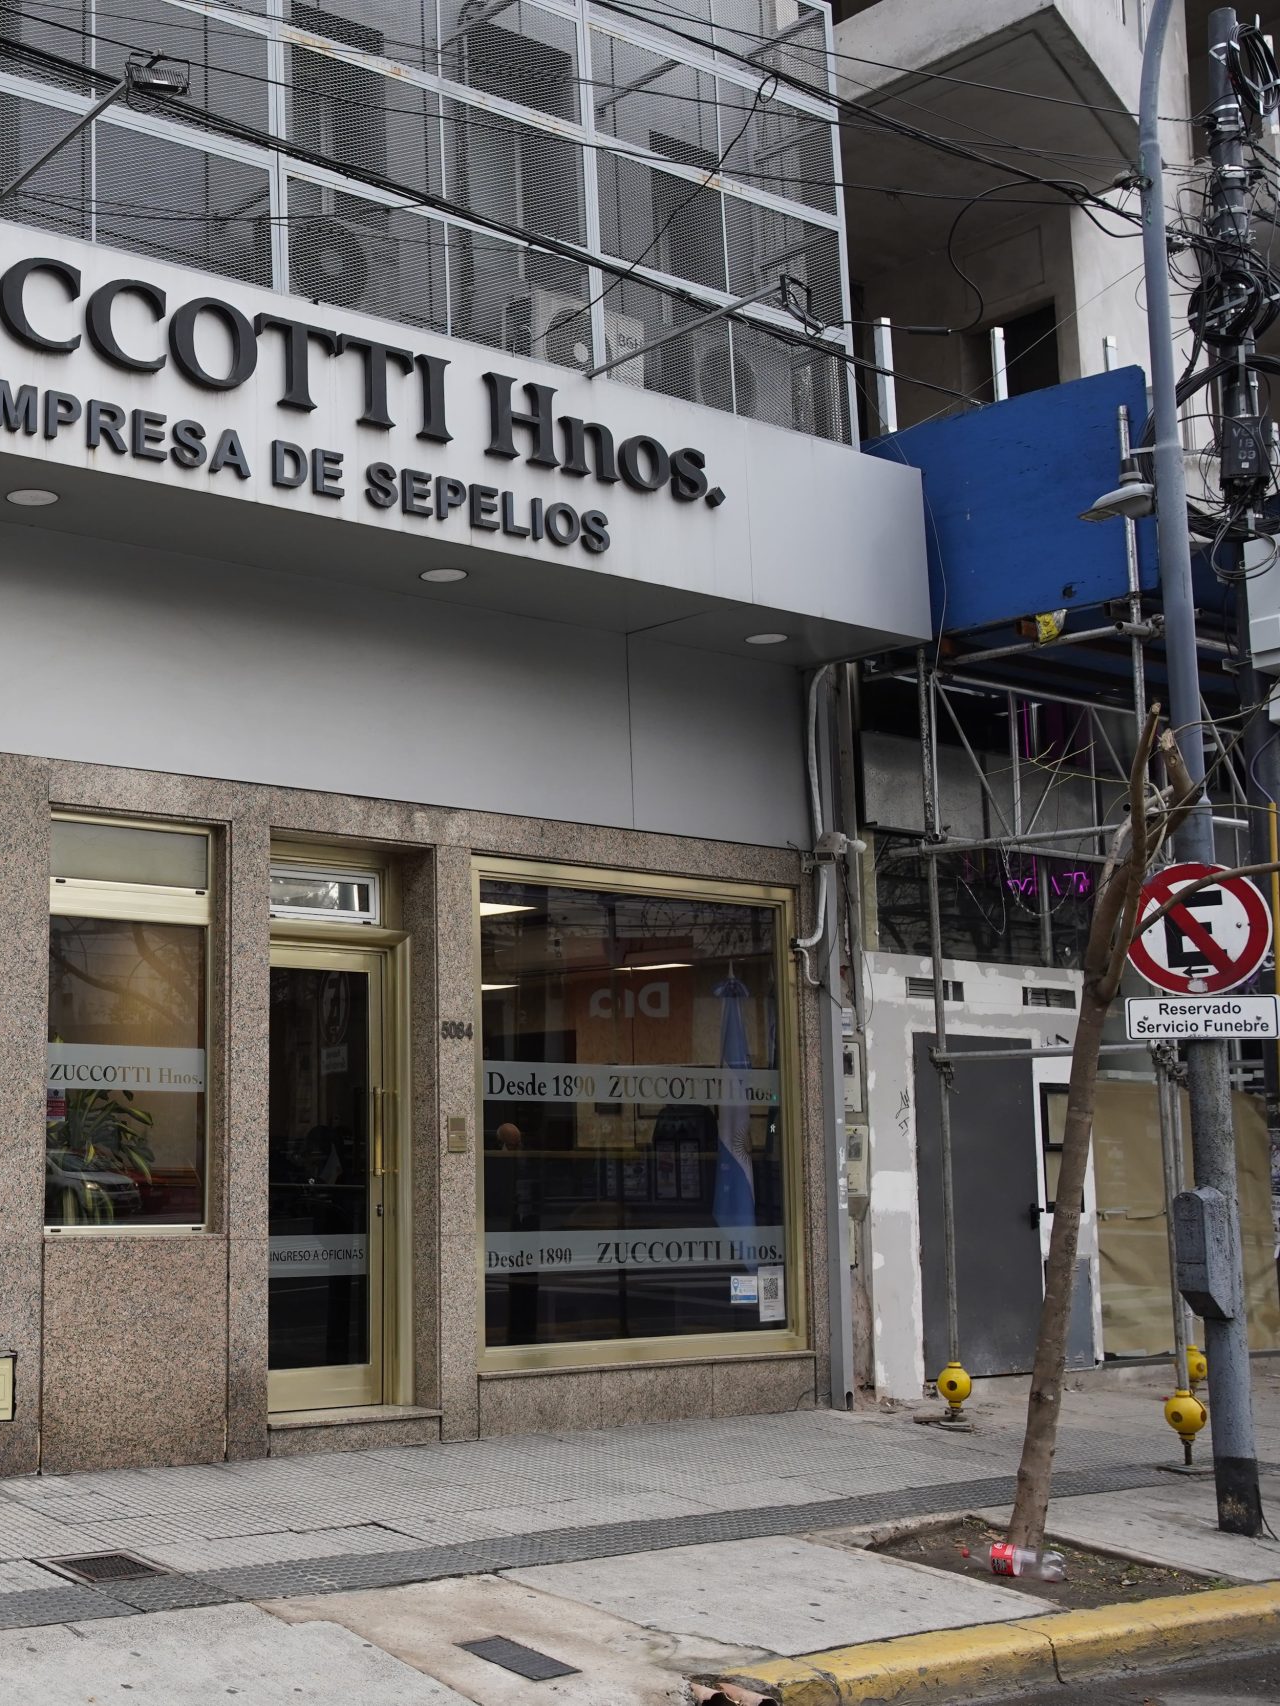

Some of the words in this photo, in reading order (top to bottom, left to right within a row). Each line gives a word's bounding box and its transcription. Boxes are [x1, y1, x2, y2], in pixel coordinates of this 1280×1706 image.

[484, 372, 727, 510] Hnos.
[271, 439, 345, 499] DE
[365, 462, 612, 554] SEPELIOS
[1158, 1001, 1242, 1016] Reservado
[440, 1019, 474, 1041] 5084
[1136, 1020, 1199, 1034] Servicio
[1204, 1019, 1270, 1033] Funebre
[49, 1063, 151, 1083] ZUCCOTTI
[158, 1067, 203, 1086] Hnos.
[486, 1071, 547, 1096] Desde
[552, 1074, 595, 1097] 1890
[607, 1075, 723, 1100] ZUCCOTTI
[269, 1250, 311, 1262] INGRESO
[313, 1250, 320, 1261] A
[321, 1248, 364, 1261] OFICINAS
[487, 1249, 533, 1268] Desde
[539, 1247, 572, 1265] 1890
[596, 1240, 720, 1264] ZUCCOTTI
